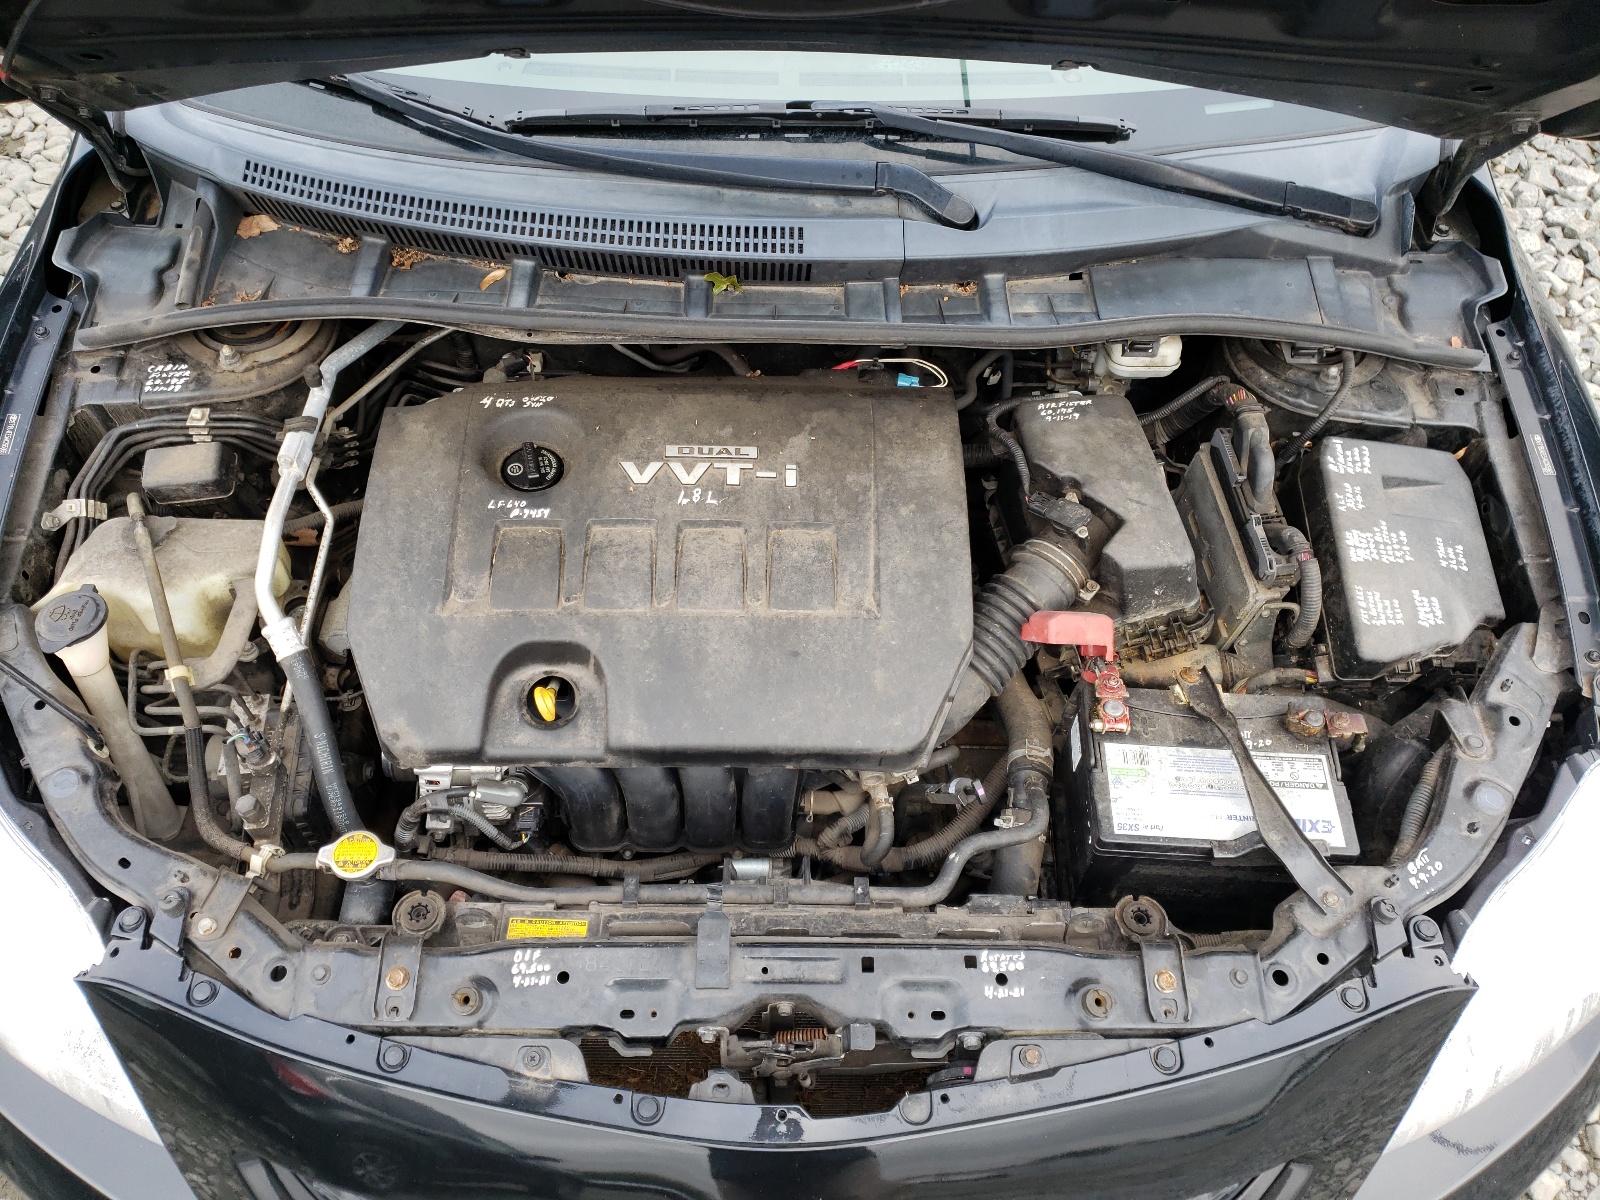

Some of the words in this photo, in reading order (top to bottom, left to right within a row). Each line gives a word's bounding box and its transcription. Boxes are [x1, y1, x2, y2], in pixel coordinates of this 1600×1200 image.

[1038, 402, 1057, 410] AIR
[676, 446, 750, 457] DUAL
[1286, 780, 1318, 790] DANGER
[1116, 823, 1140, 832] SX35
